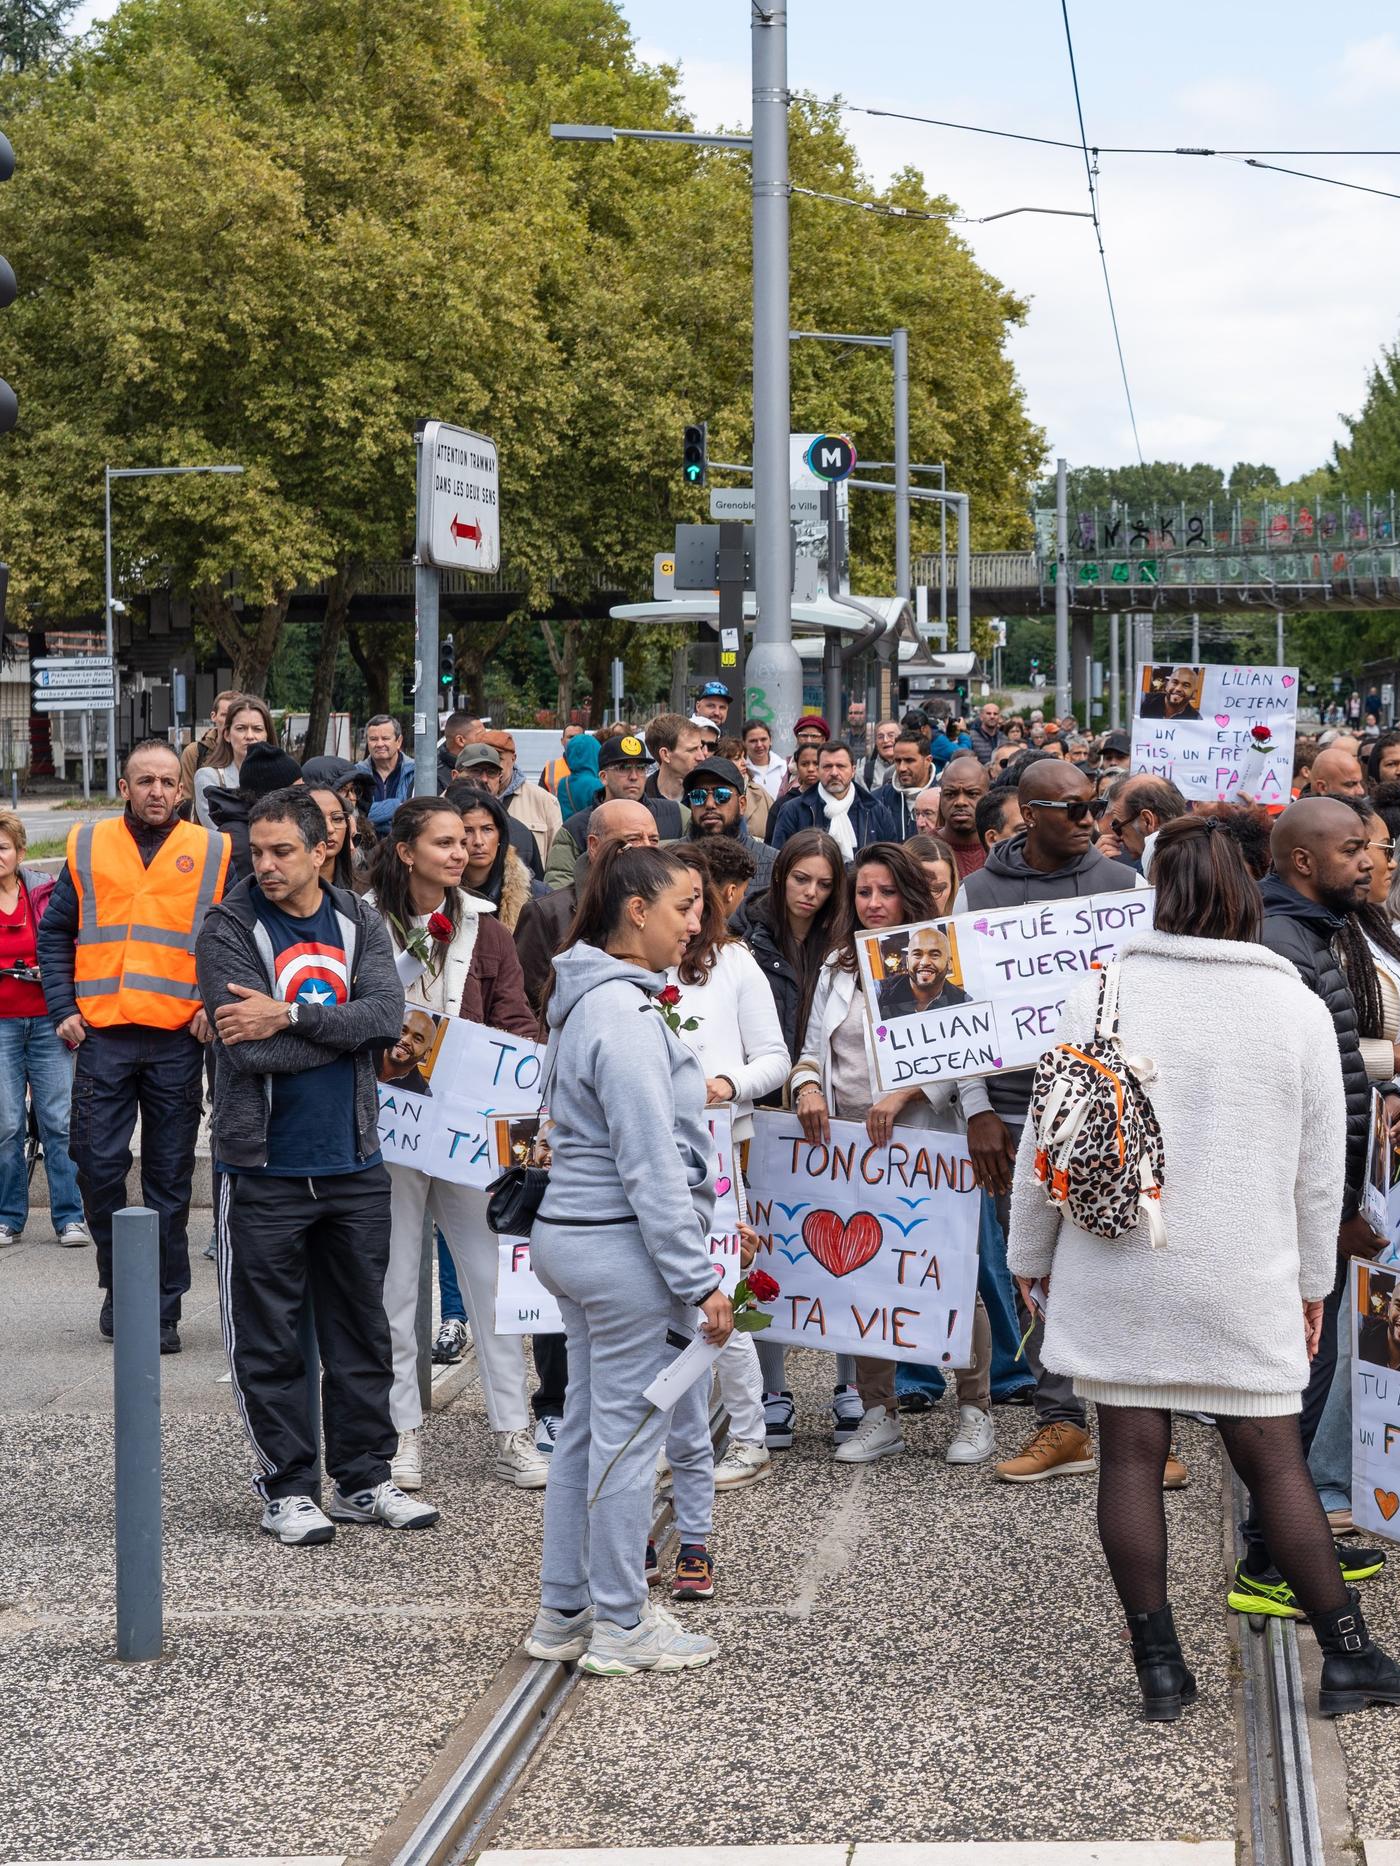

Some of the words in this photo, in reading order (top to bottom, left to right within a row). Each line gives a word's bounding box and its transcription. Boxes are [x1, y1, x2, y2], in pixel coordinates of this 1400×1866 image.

[437, 443, 468, 467] ATTENTION
[470, 452, 496, 474] TRAMWAY
[821, 447, 842, 468] M
[435, 474, 451, 494] DANS
[453, 481, 464, 497] LES
[465, 482, 480, 502] DEUX
[481, 487, 496, 506] SENS
[797, 501, 818, 511] Ville
[661, 563, 674, 572] C1
[1155, 728, 1176, 742] UN
[1182, 749, 1200, 760] UN
[1276, 757, 1290, 765] UN
[1191, 774, 1208, 785] UN
[1215, 766, 1282, 792] PAA
[1072, 902, 1147, 936] STOP
[889, 1011, 991, 1051] LILIAN
[891, 1044, 995, 1083] DEJEAN
[778, 1135, 857, 1186] TON
[859, 1142, 979, 1194] GRAND
[890, 1248, 942, 1292] T'A
[517, 1308, 540, 1322] UN
[783, 1295, 828, 1337] TA
[850, 1304, 922, 1349] VIE
[1357, 1371, 1388, 1402] TU
[1358, 1426, 1376, 1448] UN
